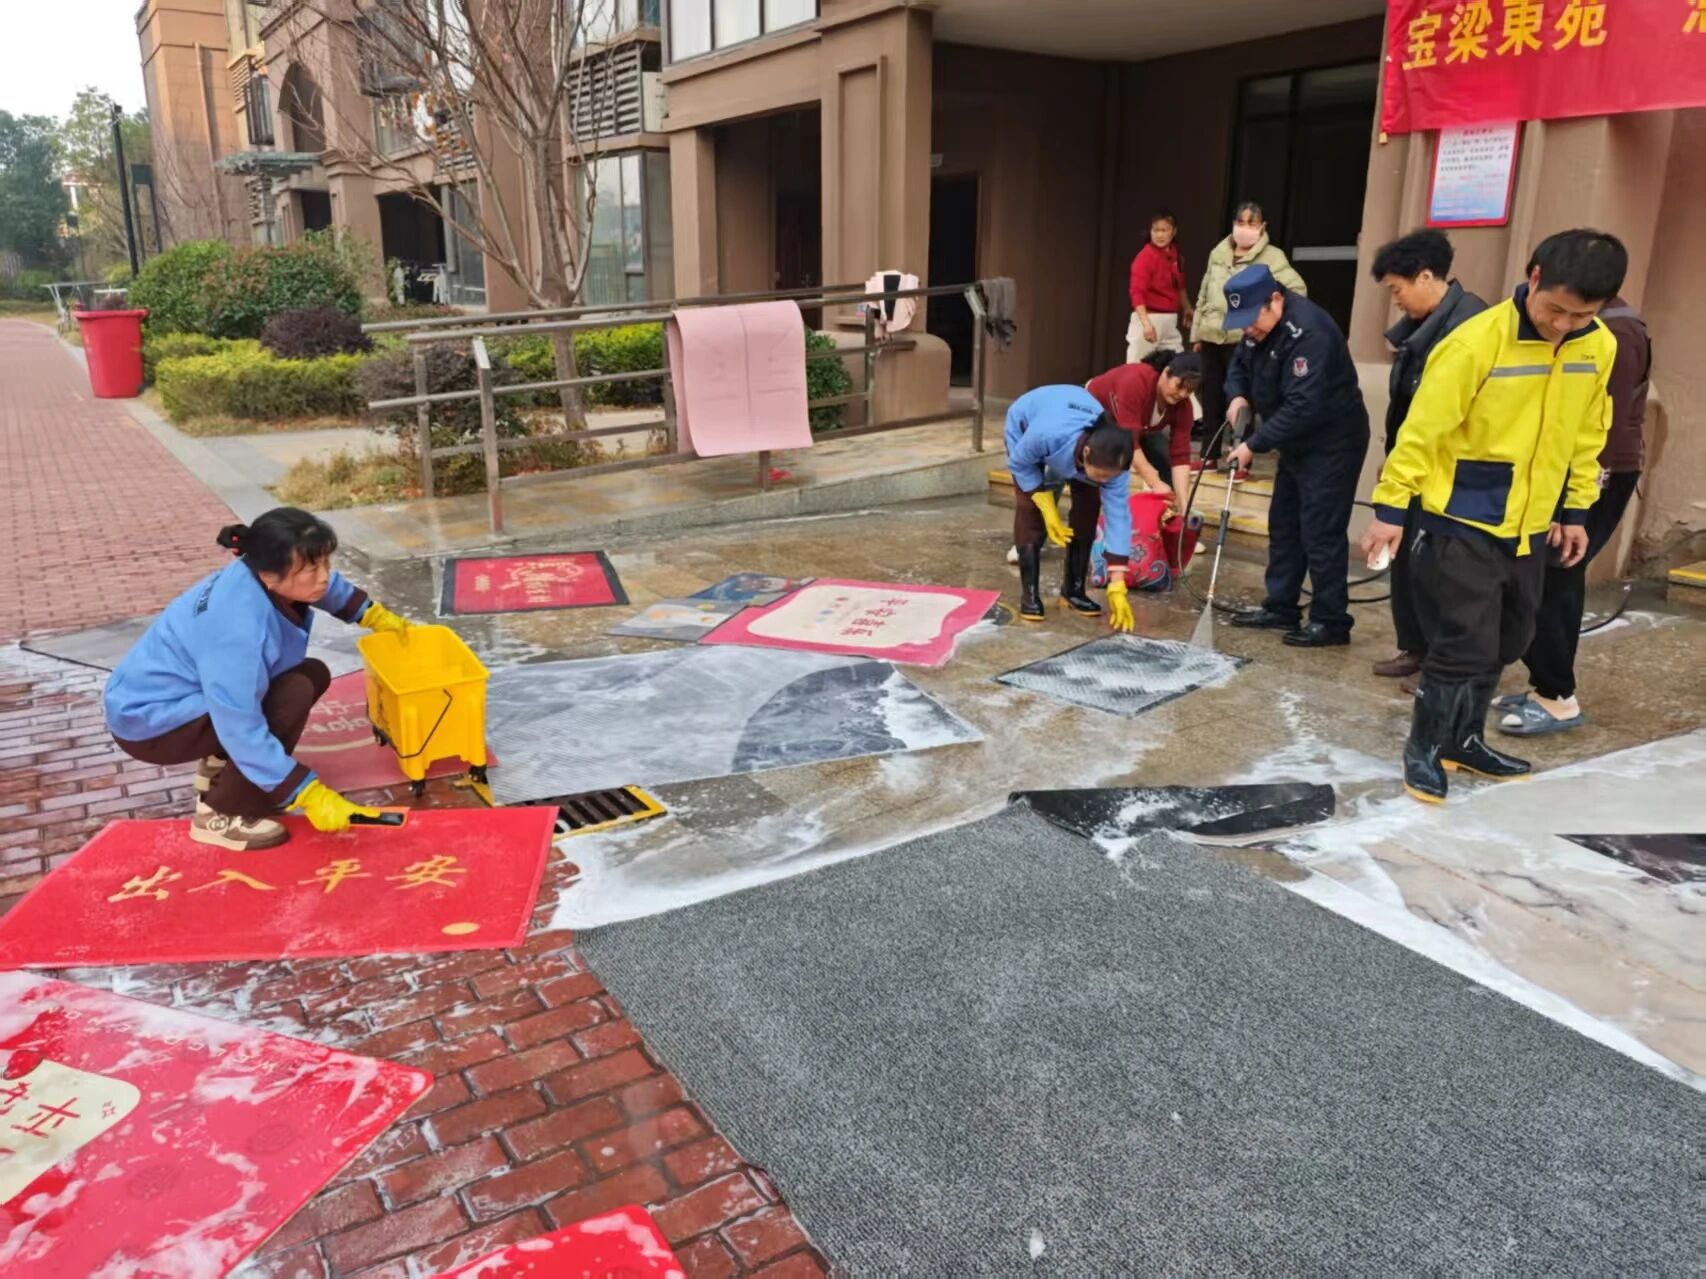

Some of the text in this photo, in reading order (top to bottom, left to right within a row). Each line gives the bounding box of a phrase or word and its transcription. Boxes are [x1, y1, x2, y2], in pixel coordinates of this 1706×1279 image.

[1401, 0, 1608, 71] 宝梁東苑
[106, 854, 467, 903] 出入平安
